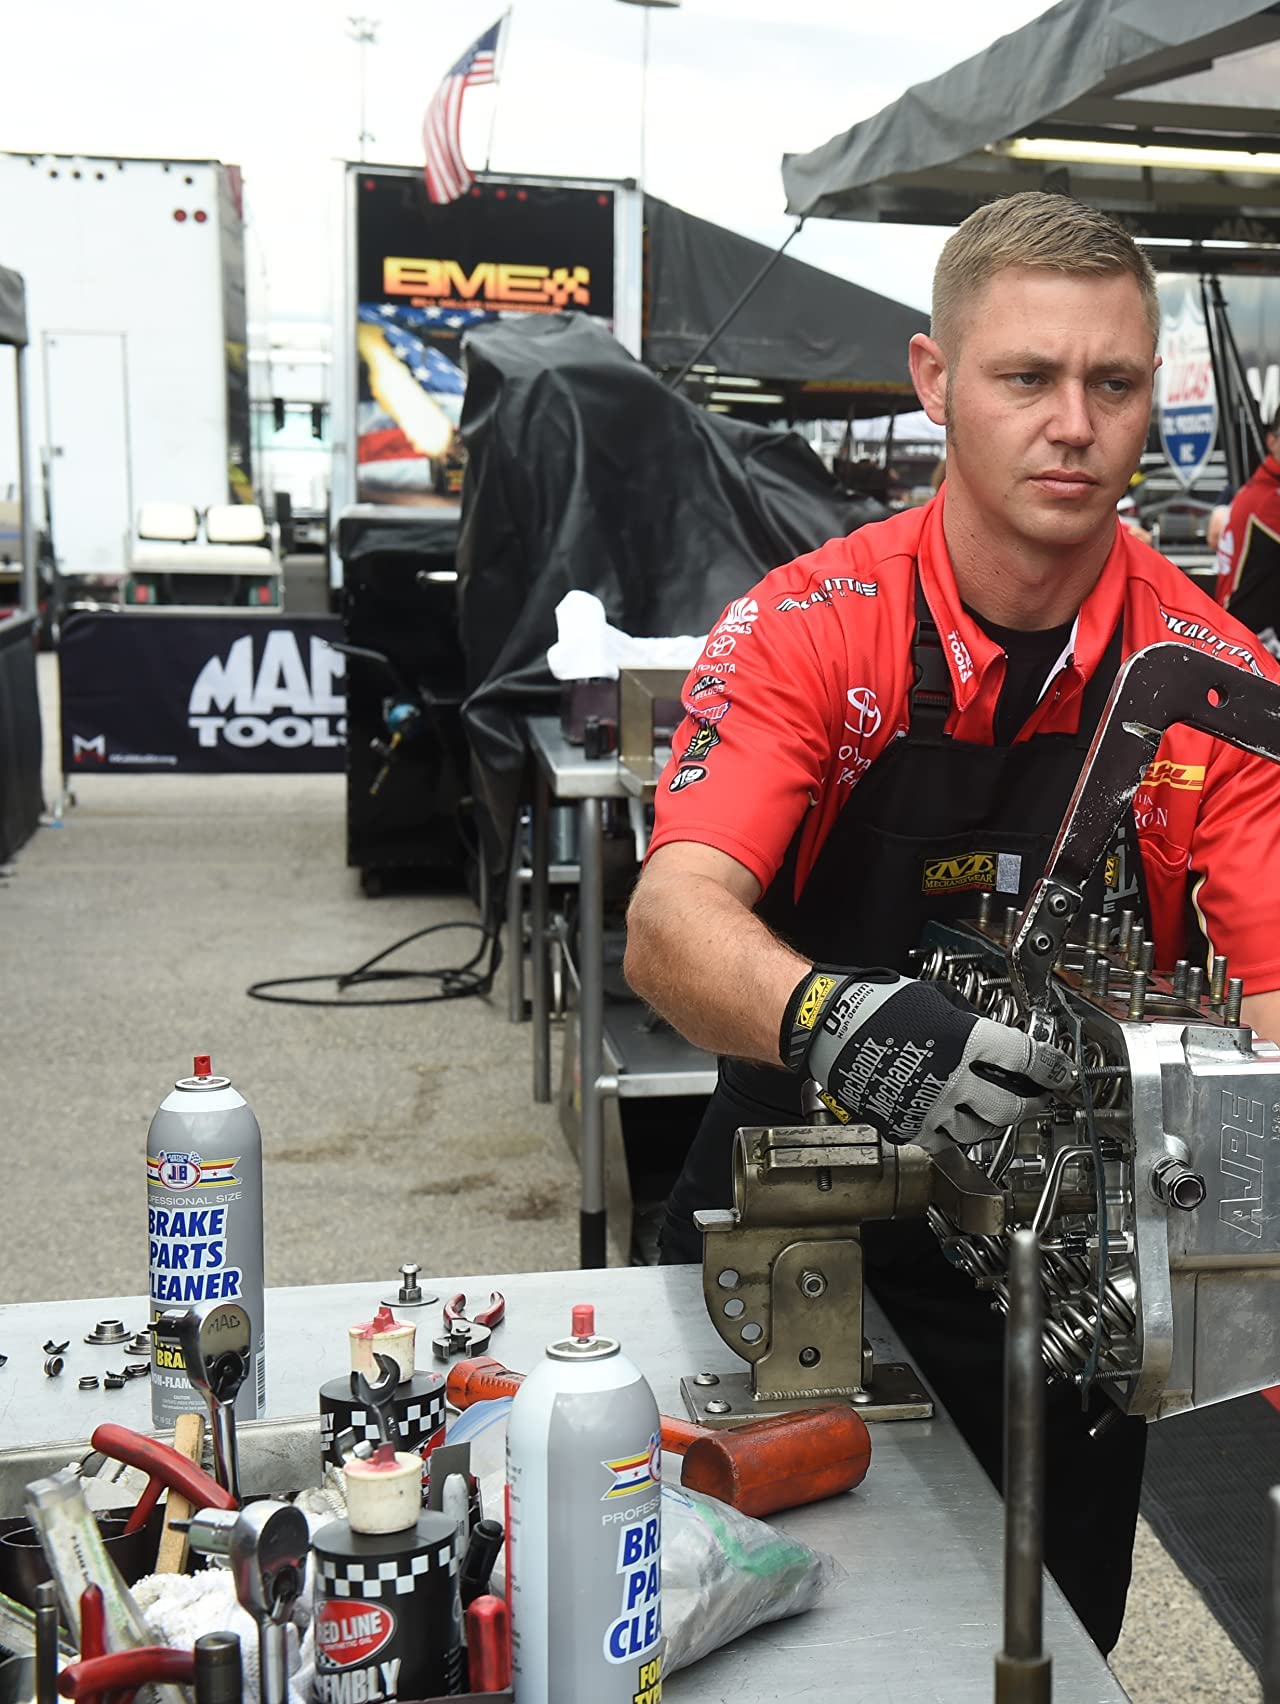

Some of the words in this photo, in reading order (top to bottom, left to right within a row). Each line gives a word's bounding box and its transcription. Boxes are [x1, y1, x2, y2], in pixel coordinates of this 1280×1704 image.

[1165, 615, 1254, 665] KALITTA
[948, 631, 973, 683] TOOLS
[838, 1021, 852, 1040] High
[848, 986, 875, 1021] Dexterity
[838, 1036, 887, 1114] Mechanix
[866, 1039, 927, 1122] Mechanix
[1219, 1089, 1265, 1239] AJPE
[149, 1194, 213, 1206] FESSIONAL
[216, 1191, 243, 1203] SIZE
[149, 1208, 225, 1238] BRAKE
[150, 1240, 225, 1270] PARTS
[149, 1270, 240, 1301] LEANER
[156, 1349, 187, 1369] BRA
[601, 1498, 661, 1526] PROFESS
[341, 1610, 384, 1641] LINE
